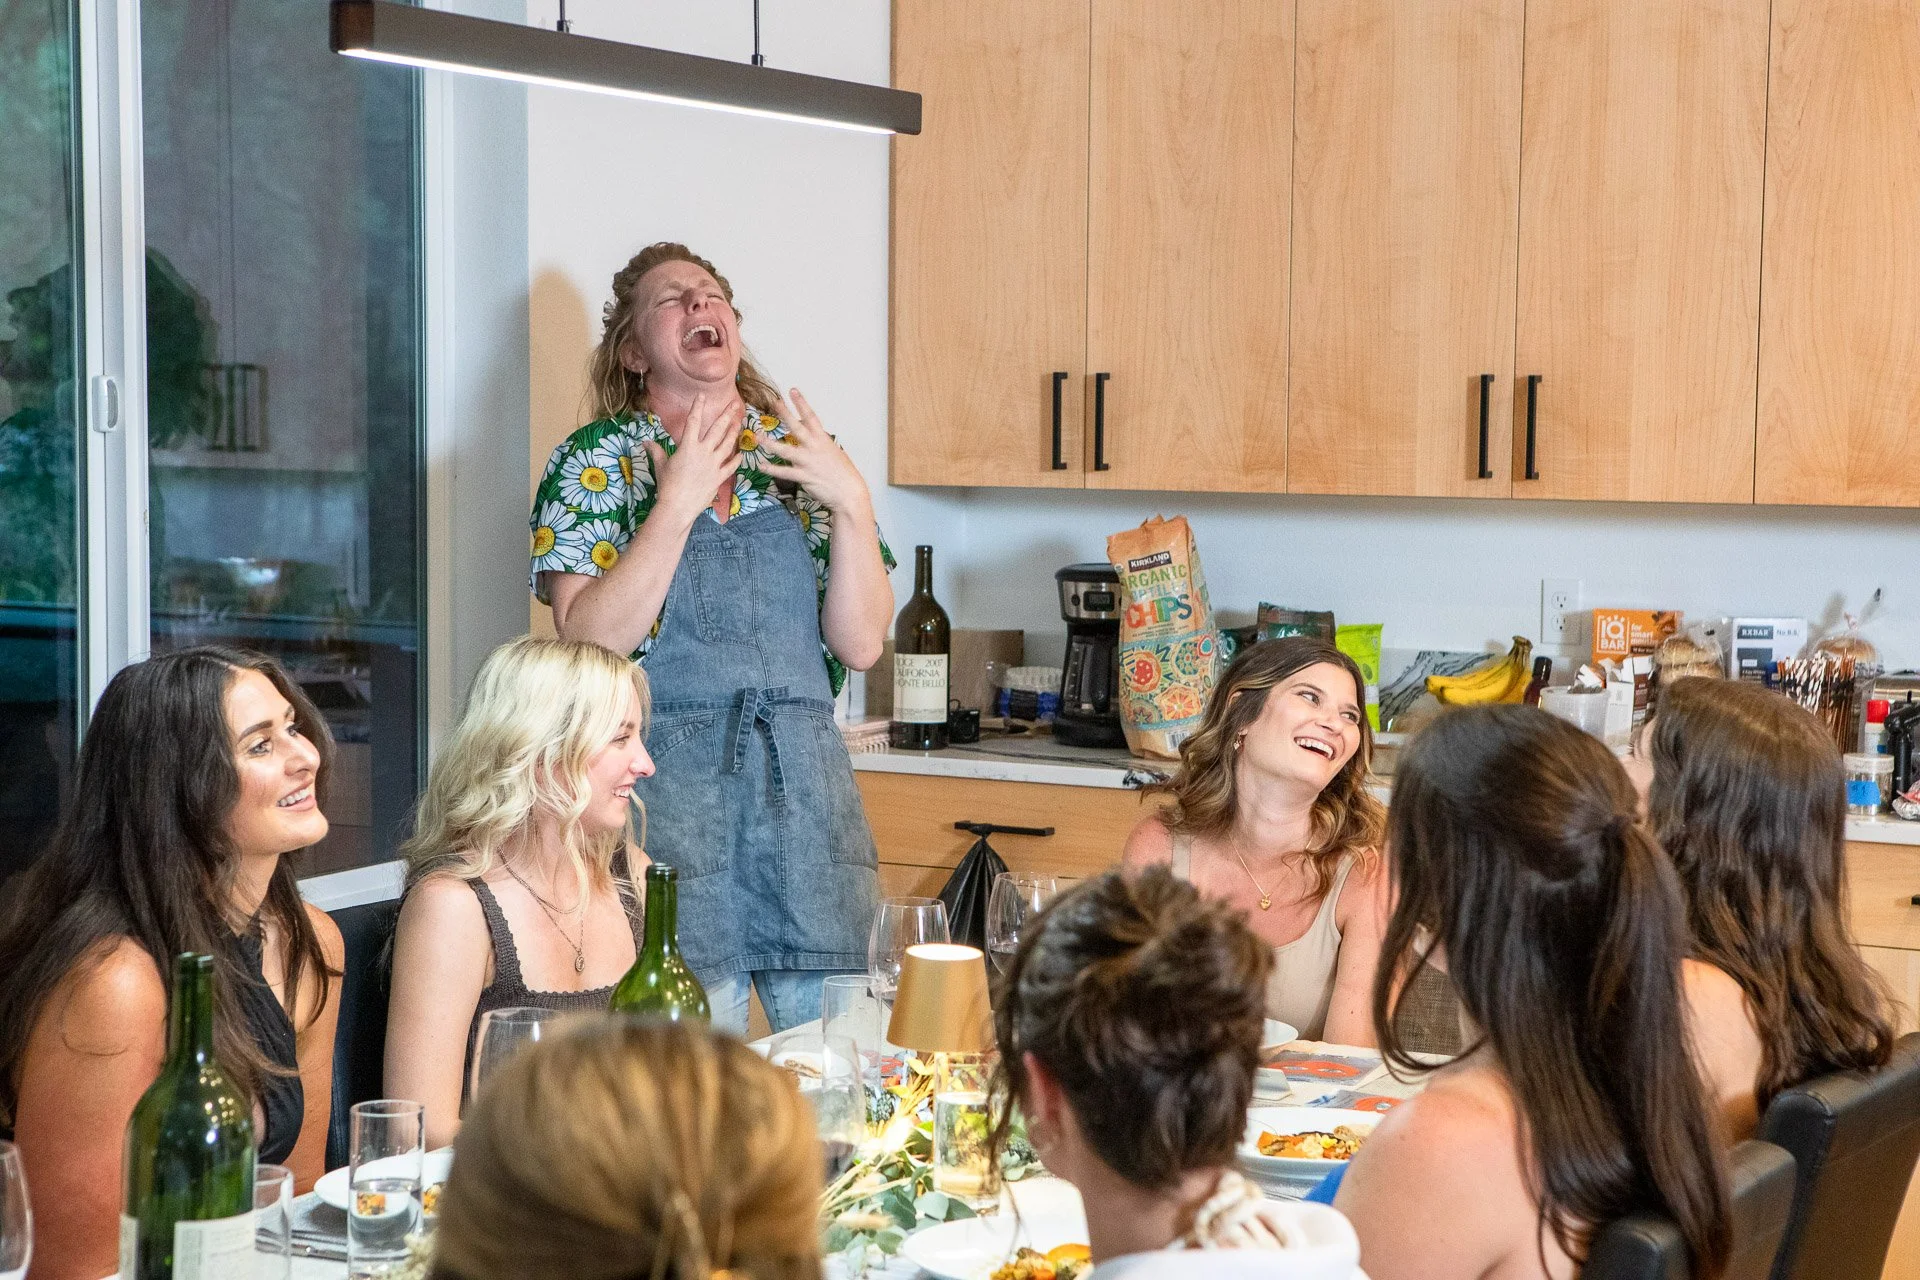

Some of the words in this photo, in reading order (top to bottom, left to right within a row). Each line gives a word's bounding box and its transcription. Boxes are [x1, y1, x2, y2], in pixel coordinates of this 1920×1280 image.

[1130, 552, 1170, 568] KIRKLAND
[1125, 594, 1193, 629] CHIPS
[1601, 639, 1625, 650] BAR
